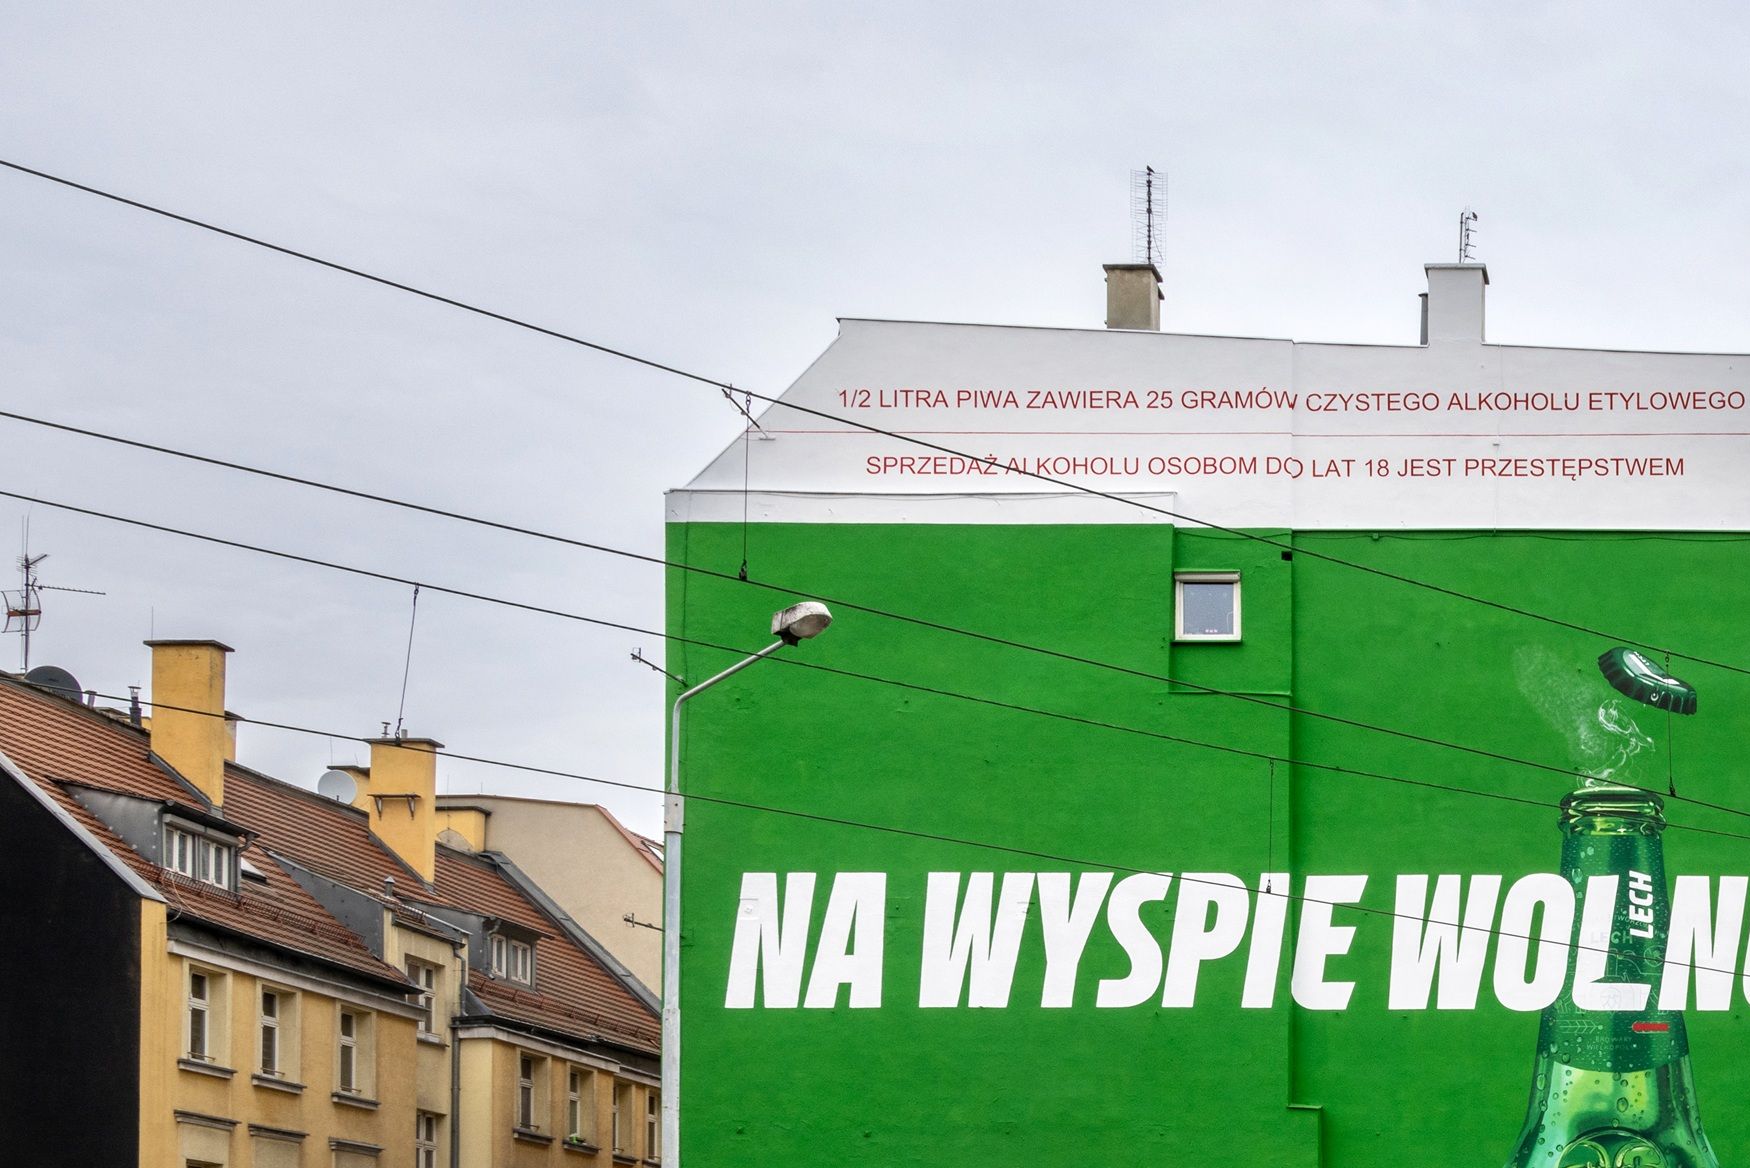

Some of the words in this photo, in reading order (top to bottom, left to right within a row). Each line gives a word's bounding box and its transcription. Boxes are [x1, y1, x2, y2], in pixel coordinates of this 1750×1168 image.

[838, 389, 872, 409] 1/2
[879, 389, 949, 409] LITRA
[956, 389, 1019, 409] PIWA
[1026, 390, 1140, 409] ZAWIERA
[1146, 390, 1174, 409] 25
[1180, 387, 1298, 411] GRAMÓW
[1305, 391, 1440, 412] CZYSTEGO
[1447, 391, 1580, 412] ALKOHOLU
[1588, 390, 1746, 411] ETYLOWEGO
[866, 453, 998, 476] SPRZEDAŻ
[1005, 456, 1139, 476] ALKOHOLU
[1148, 456, 1257, 476] OSOBOM
[1266, 456, 1304, 479] DO
[1312, 458, 1356, 478] LAT
[1364, 458, 1390, 478] 18
[1397, 458, 1457, 478] JEST
[1464, 457, 1685, 482] PRZESTĘPSTWEM
[1629, 870, 1654, 939] LECH
[725, 872, 887, 1009] NA
[919, 872, 1369, 1011] WYSPIE
